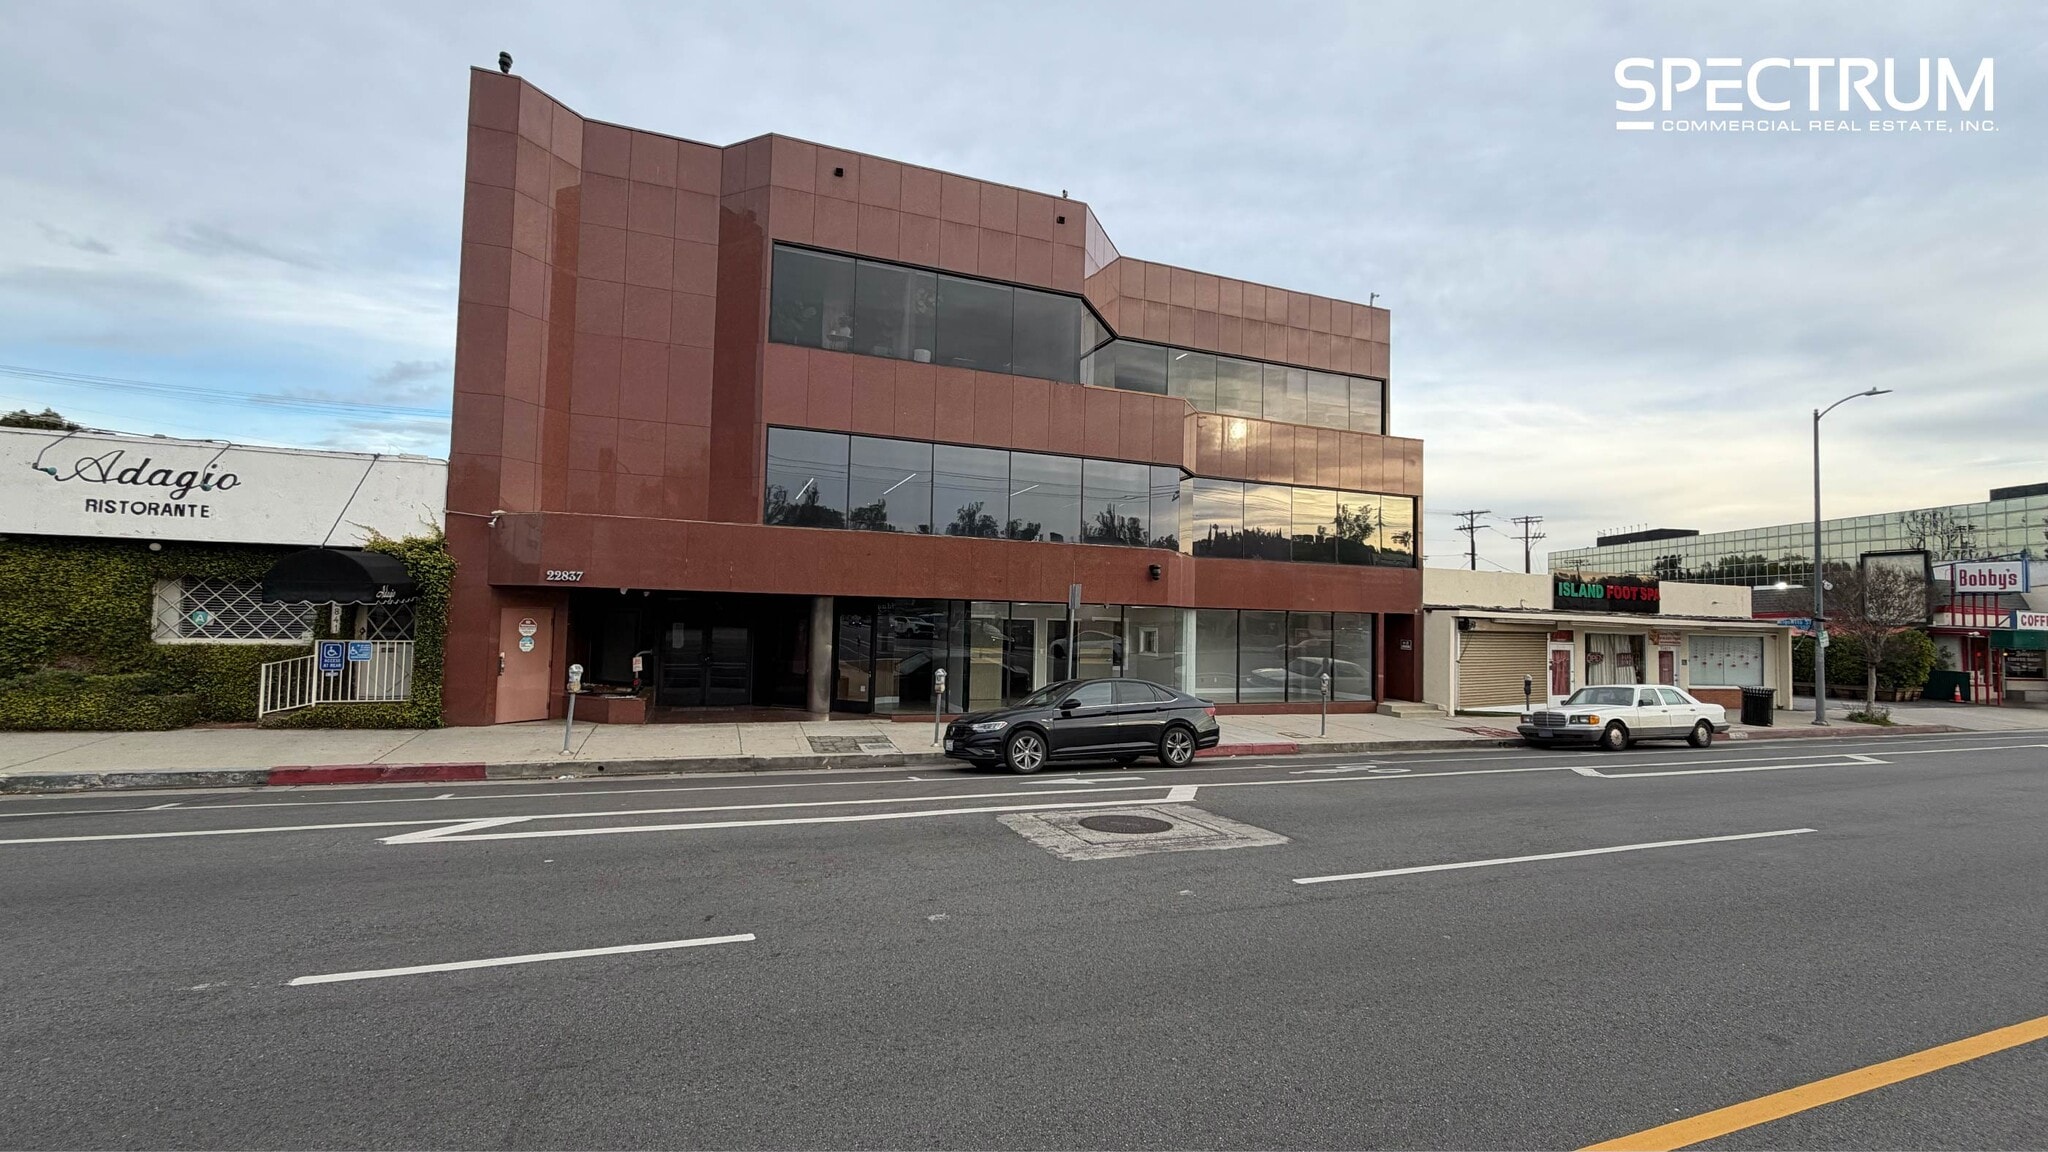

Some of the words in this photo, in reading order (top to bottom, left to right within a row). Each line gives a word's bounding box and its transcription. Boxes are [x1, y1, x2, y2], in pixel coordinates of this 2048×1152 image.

[55, 450, 241, 500] Adagio
[85, 498, 210, 518] RISTORANTE
[546, 570, 584, 581] 22837
[1959, 568, 2018, 590] Bobby's
[1558, 581, 1605, 599] ISLAND
[1606, 584, 1639, 601] FOOT
[1640, 586, 1661, 601] SPA
[2020, 614, 2048, 627] COFF
